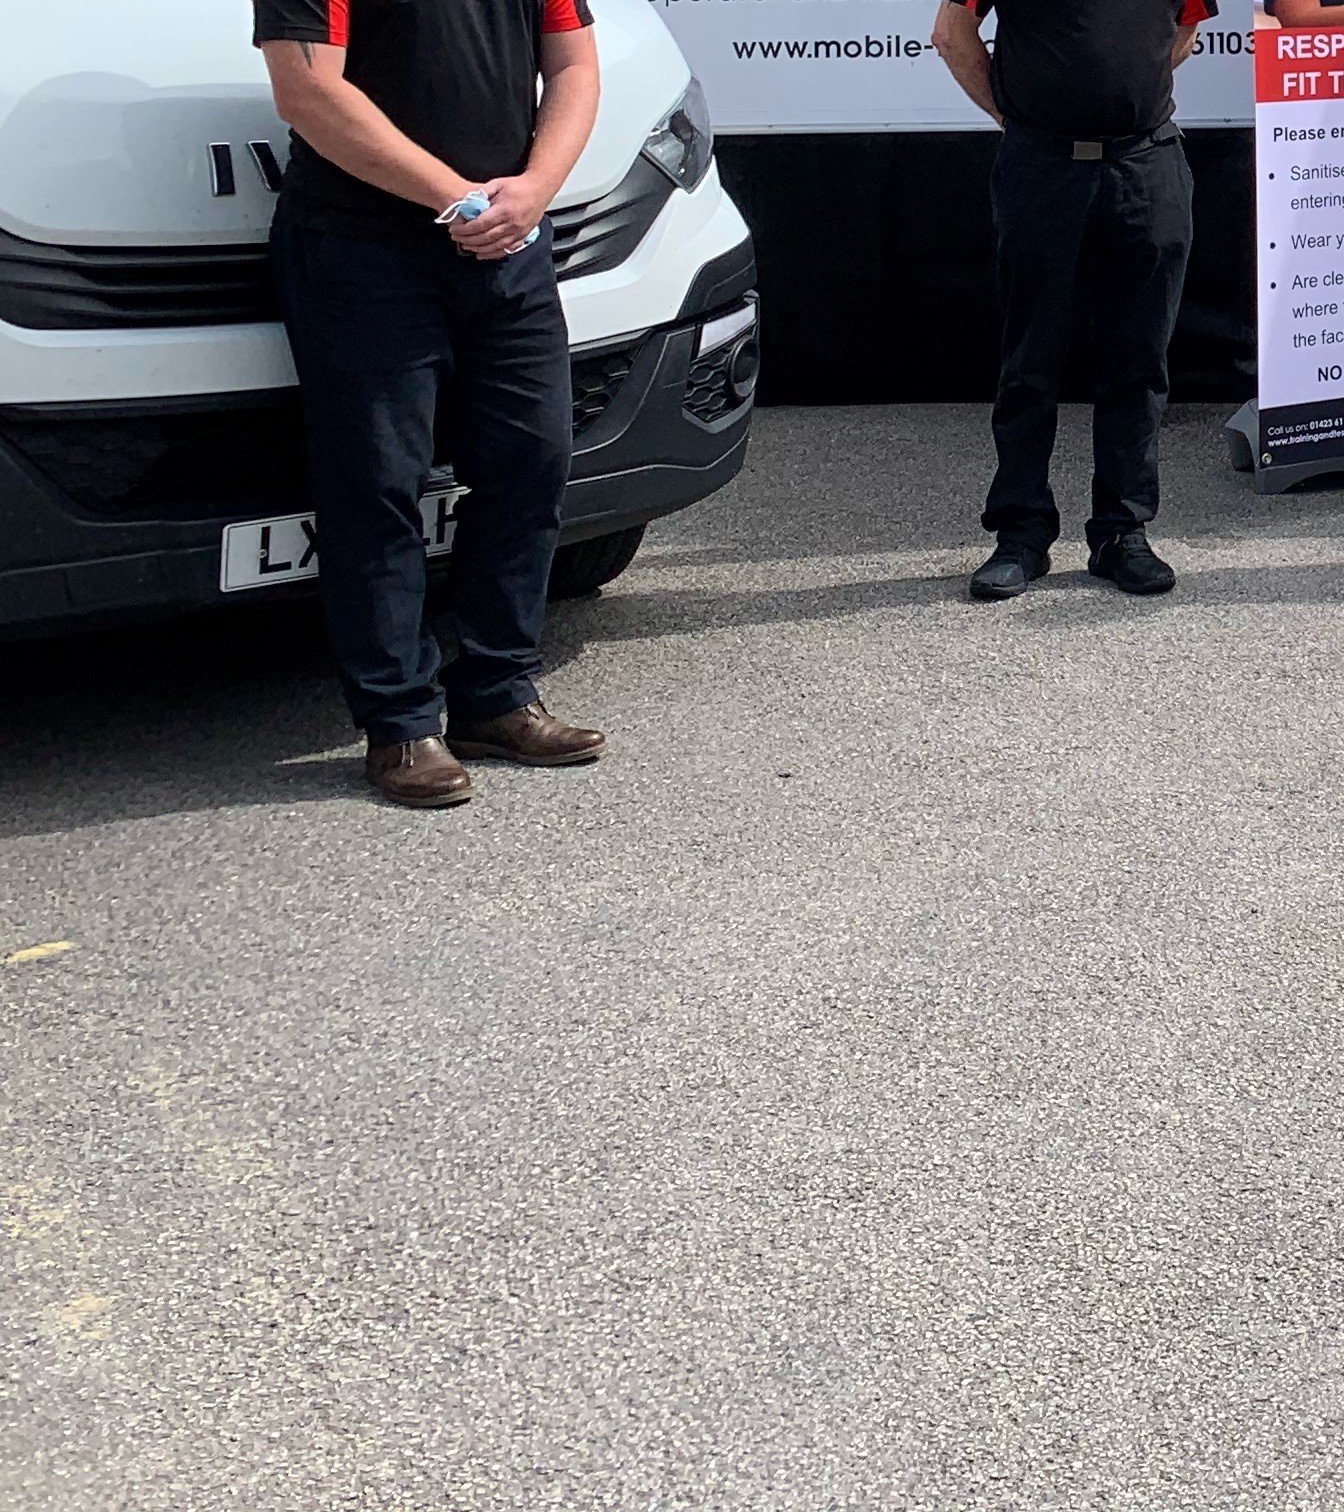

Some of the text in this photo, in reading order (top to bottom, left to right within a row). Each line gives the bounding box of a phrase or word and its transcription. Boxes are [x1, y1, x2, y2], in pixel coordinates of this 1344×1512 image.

[733, 35, 937, 60] www.mobile-
[1283, 71, 1322, 97] FIT
[1273, 126, 1326, 142] Please
[1291, 234, 1332, 250] Wear
[1291, 274, 1318, 290] Are
[1292, 303, 1339, 319] where
[1292, 332, 1317, 349] the
[1318, 365, 1343, 382] NO
